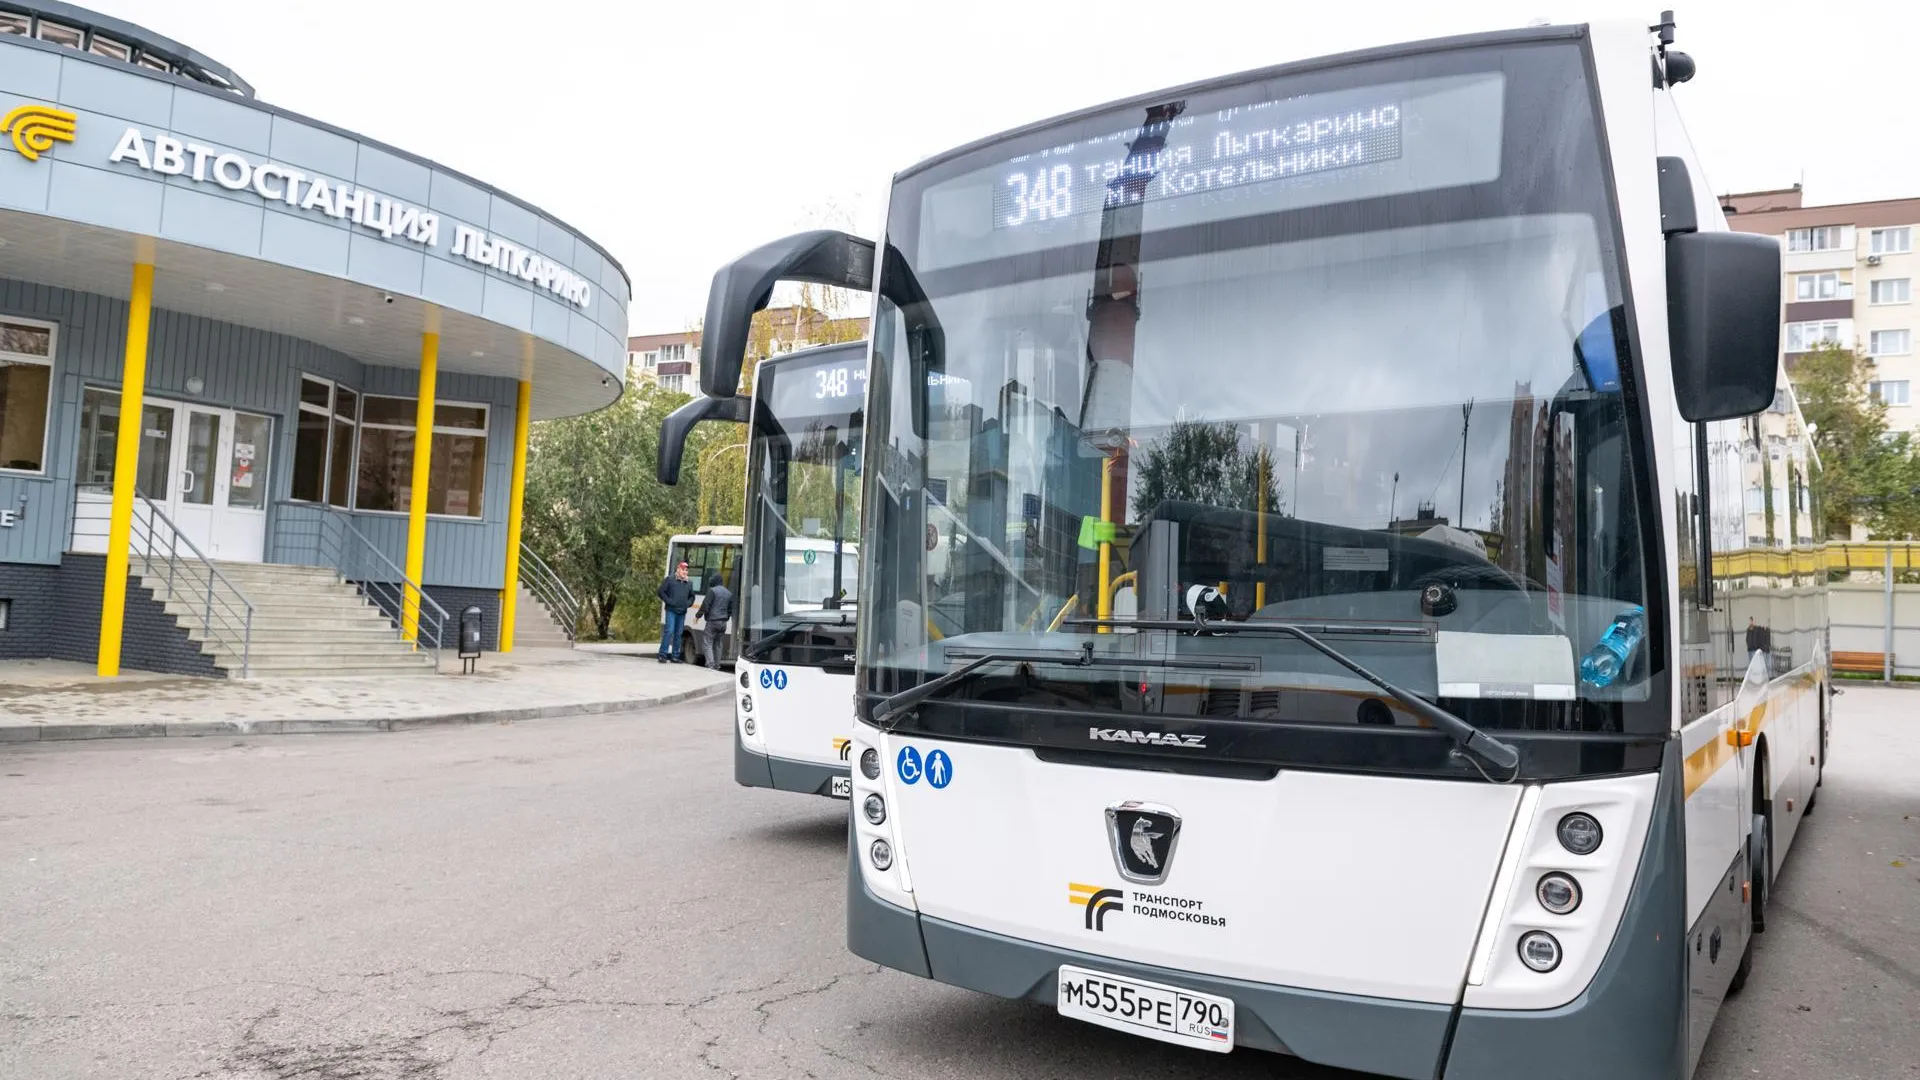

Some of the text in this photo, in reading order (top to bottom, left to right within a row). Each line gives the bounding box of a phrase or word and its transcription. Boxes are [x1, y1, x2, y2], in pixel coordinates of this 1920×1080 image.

[1085, 146, 1192, 183] танция
[1213, 104, 1399, 159] Лыткарино
[1162, 141, 1362, 195] Котельники
[1007, 164, 1072, 226] 348
[109, 127, 591, 308] АВТОСТАНЦИЯ ЛЫТКАРИНО
[815, 368, 848, 399] 348
[1089, 727, 1207, 748] KAMAZ
[1133, 892, 1203, 910] ТРАНСПОРТ
[1133, 905, 1226, 927] ПОДМОСКОВЬЯ
[1067, 979, 1223, 1027] М555РЕ 790
[1189, 1023, 1211, 1036] RUS
